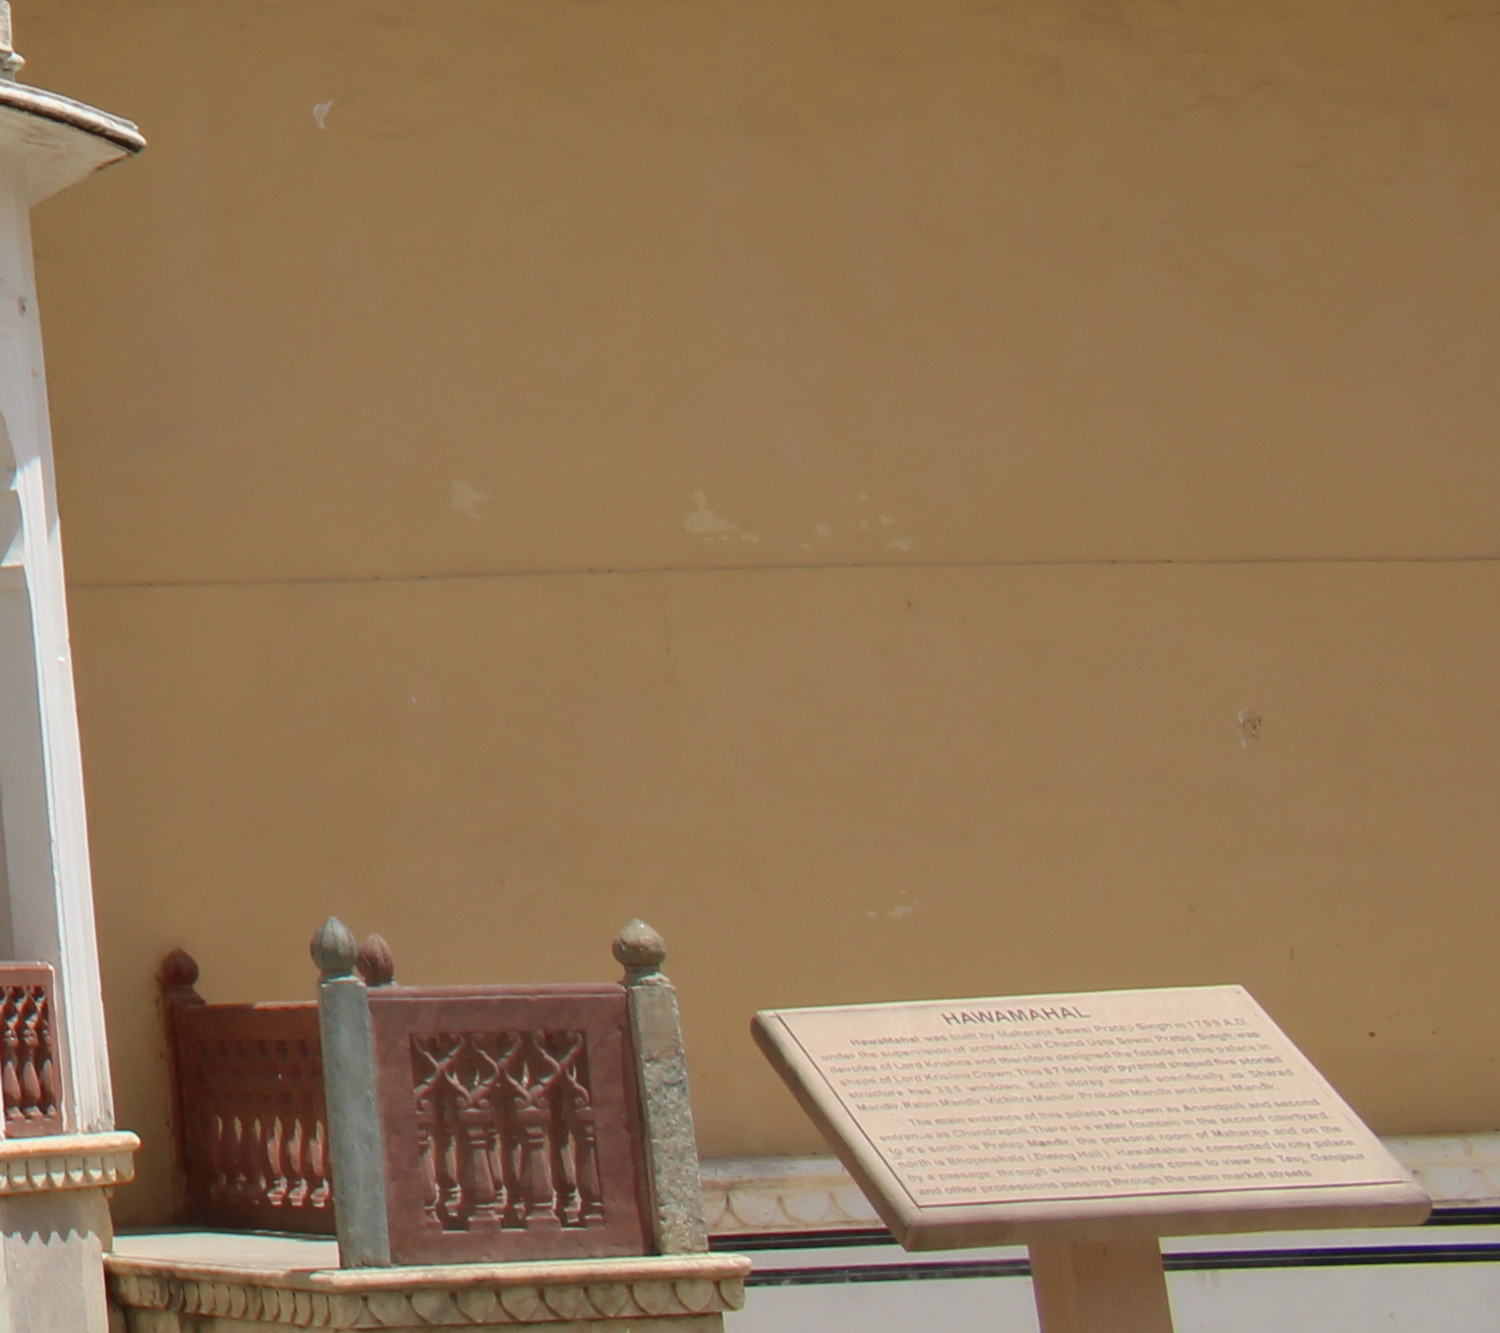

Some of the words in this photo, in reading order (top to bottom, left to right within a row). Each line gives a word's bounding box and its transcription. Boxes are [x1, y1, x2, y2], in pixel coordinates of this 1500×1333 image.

[942, 1006, 1091, 1026] HAWAMAHAL
[922, 1034, 948, 1042] was
[948, 1032, 978, 1041] built
[977, 1031, 995, 1041] by
[995, 1028, 1053, 1038] Maharaja
[1053, 1026, 1092, 1035] Sawai
[1134, 1021, 1173, 1032] Singh
[819, 1051, 855, 1061] under
[856, 1050, 878, 1058] the
[879, 1047, 951, 1058] supervision
[952, 1044, 966, 1053] of
[968, 1042, 1022, 1052] architect
[1022, 1041, 1043, 1049] Lal
[1043, 1038, 1085, 1049] Chand
[1115, 1036, 1154, 1045] Sawai
[1195, 1031, 1233, 1042] Singh
[879, 1061, 892, 1070] of
[892, 1060, 923, 1070] Lord
[922, 1059, 972, 1068] Krishna
[973, 1056, 997, 1065] and
[996, 1054, 1054, 1064] therefore
[1054, 1050, 1112, 1061] designed
[1110, 1050, 1133, 1058] the
[1132, 1047, 1175, 1057] facade
[1176, 1046, 1190, 1055] of
[1189, 1046, 1214, 1054] this
[1215, 1044, 1257, 1054] palace
[838, 1077, 877, 1086] shape
[878, 1074, 892, 1084] of
[891, 1073, 923, 1083] Lord
[922, 1072, 972, 1081] Krishna
[1014, 1067, 1043, 1076] This
[1060, 1065, 1087, 1074] feet
[1086, 1064, 1116, 1074] high
[1116, 1060, 1167, 1073] pyramid
[1167, 1058, 1214, 1069] shaped
[1212, 1057, 1237, 1066] five
[847, 1089, 904, 1099] structure
[906, 1087, 932, 1095] has
[1026, 1079, 1060, 1089] Each
[1064, 1078, 1104, 1087] storey
[1108, 1074, 1151, 1085] named
[1154, 1071, 1224, 1083] specifically
[1229, 1071, 1245, 1079] as
[1247, 1067, 1294, 1078] Sharad
[900, 1100, 939, 1109] Ratan
[982, 1095, 1033, 1104] Vichitra
[1077, 1089, 1130, 1099] Prakash
[1128, 1087, 1172, 1096] Mandir
[1173, 1085, 1198, 1095] and
[1196, 1085, 1233, 1094] Hawa
[906, 1117, 933, 1126] The
[933, 1117, 966, 1125] main
[1023, 1111, 1037, 1121] of
[1036, 1111, 1063, 1119] this
[1063, 1109, 1106, 1119] palace
[1119, 1106, 1164, 1115] known
[1247, 1100, 1272, 1109] and
[1272, 1097, 1321, 1108] second
[1028, 1124, 1068, 1133] There
[1092, 1121, 1127, 1130] water
[1127, 1118, 1181, 1128] fountain
[1195, 1117, 1218, 1125] the
[1218, 1113, 1266, 1124] second
[887, 1146, 903, 1155] to
[927, 1143, 965, 1153] south
[1074, 1136, 1097, 1145] the
[1099, 1132, 1156, 1145] personal
[1158, 1132, 1193, 1141] room
[1195, 1129, 1209, 1139] of
[1209, 1128, 1270, 1138] Maharaja
[1272, 1125, 1298, 1135] and
[1300, 1126, 1318, 1134] on
[1318, 1124, 1342, 1133] the
[897, 1158, 932, 1168] north
[1032, 1151, 1077, 1161] Dining
[1075, 1149, 1103, 1158] Hall
[1204, 1141, 1272, 1152] connected
[1270, 1141, 1286, 1149] to
[1287, 1139, 1311, 1150] city
[1312, 1138, 1355, 1149] palace
[905, 1173, 923, 1183] by
[995, 1166, 1048, 1177] through
[1049, 1164, 1089, 1174] which
[1090, 1162, 1124, 1173] royal
[1123, 1161, 1164, 1170] ladies
[1166, 1159, 1203, 1169] come
[1203, 1158, 1219, 1166] to
[1220, 1158, 1251, 1166] view
[1252, 1155, 1275, 1164] the
[917, 1186, 942, 1195] and
[943, 1185, 977, 1194] other
[979, 1181, 1058, 1194] processions
[1059, 1179, 1112, 1189] passing
[1110, 1174, 1163, 1186] through
[1162, 1174, 1186, 1183] the
[1186, 1173, 1220, 1181] main
[1220, 1170, 1266, 1180] market
[1266, 1168, 1312, 1178] streets
